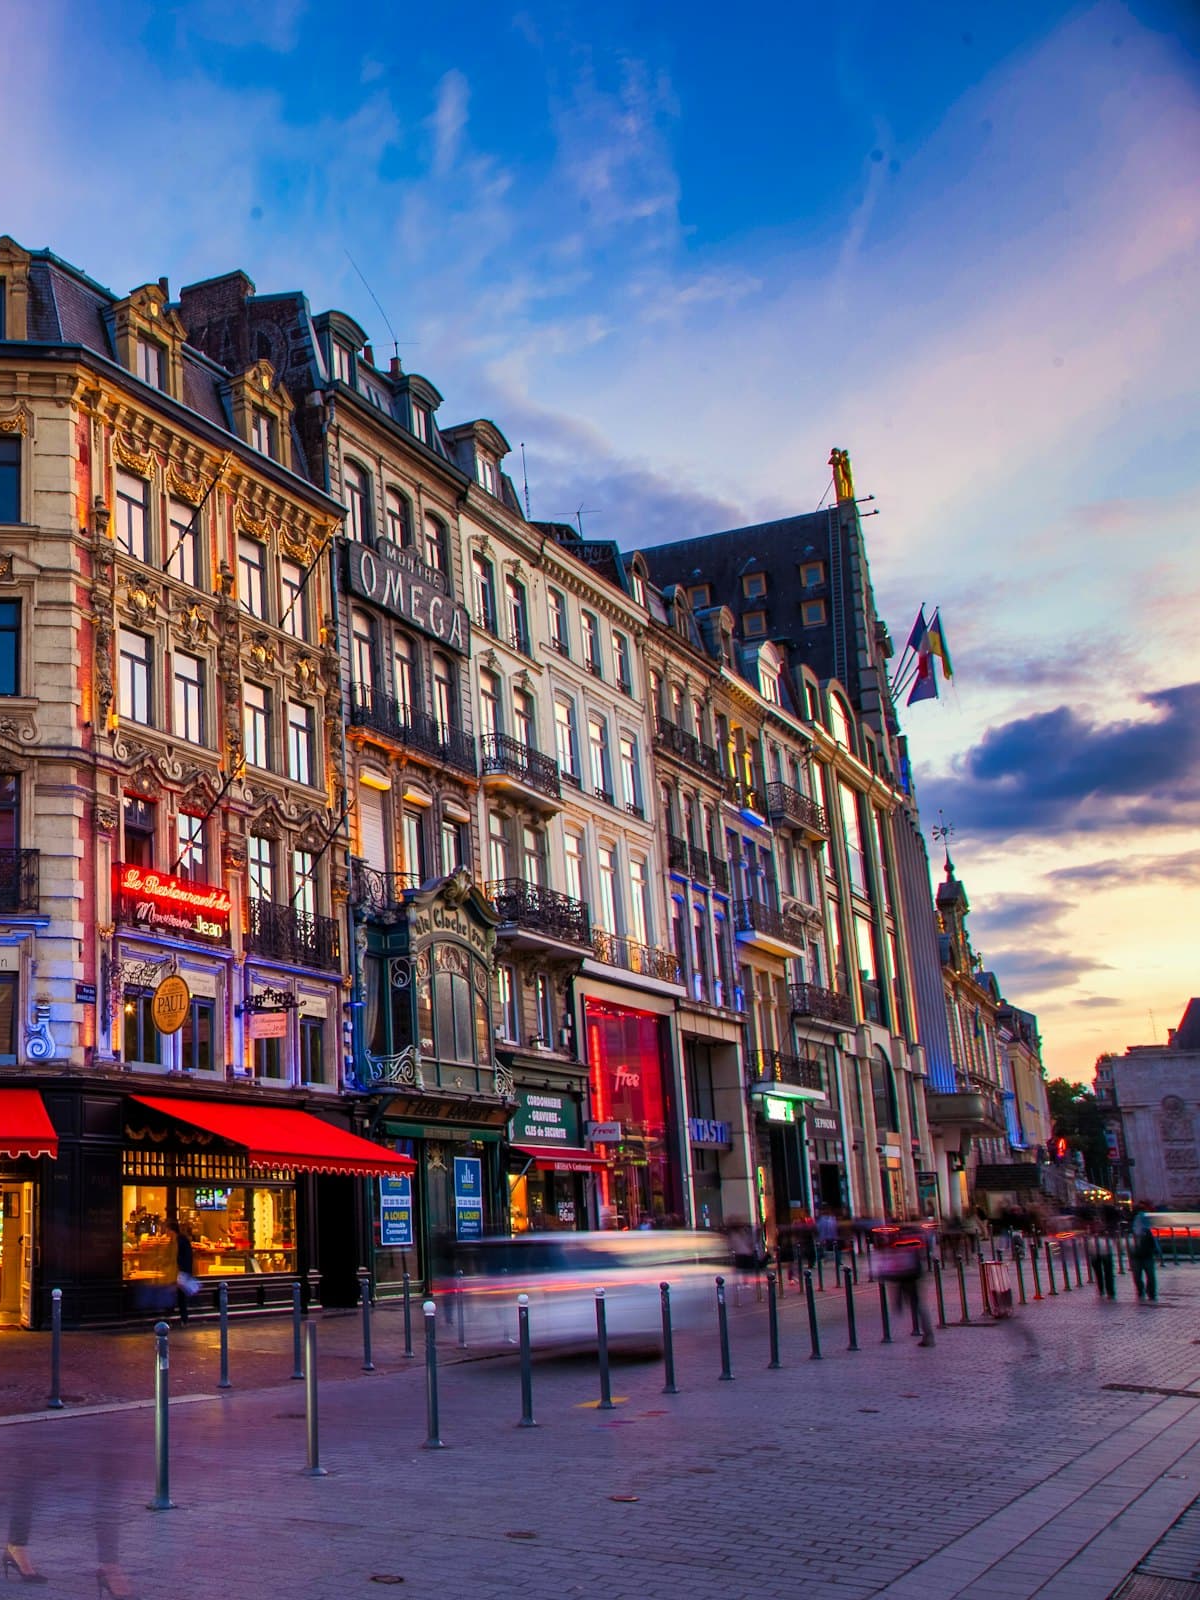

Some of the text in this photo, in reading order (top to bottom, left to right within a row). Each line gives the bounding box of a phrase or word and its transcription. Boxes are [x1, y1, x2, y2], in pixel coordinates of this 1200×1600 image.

[386, 544, 441, 589] MONTRE
[360, 550, 463, 648] OMEGA
[123, 868, 232, 912] Le Restaurant de
[192, 914, 222, 938] Jean
[433, 907, 467, 936] Cloche
[157, 994, 186, 1014] PAUL
[614, 1065, 640, 1092] free
[592, 1127, 616, 1137] free
[814, 1117, 837, 1130] SEPHORA
[384, 1211, 409, 1220] A LOUER
[464, 1211, 480, 1220] LOUER
